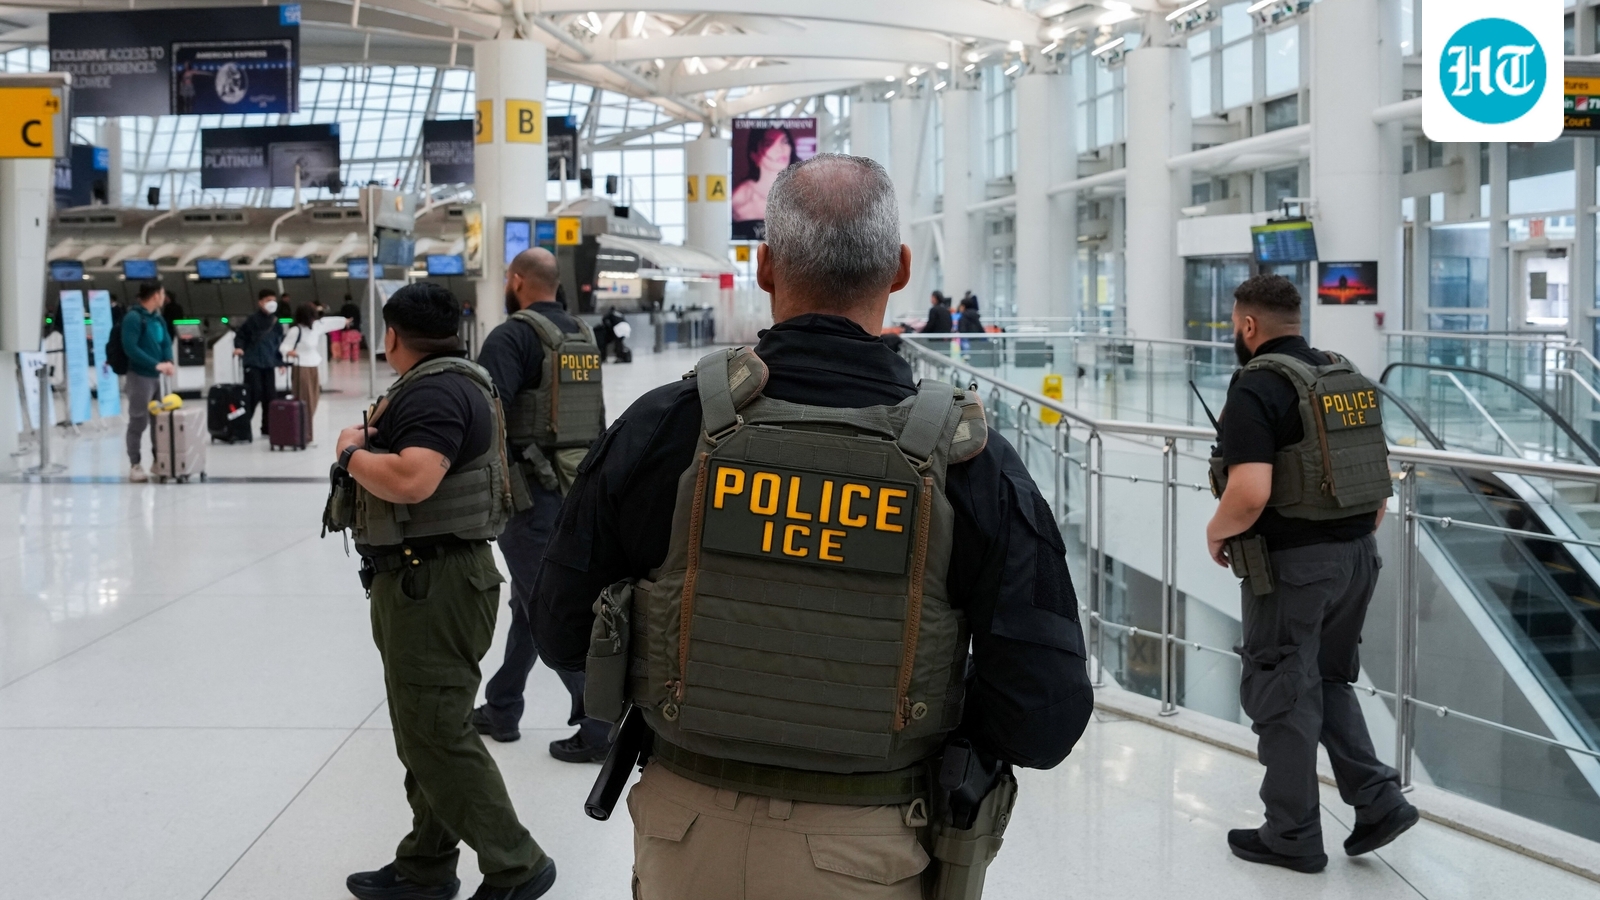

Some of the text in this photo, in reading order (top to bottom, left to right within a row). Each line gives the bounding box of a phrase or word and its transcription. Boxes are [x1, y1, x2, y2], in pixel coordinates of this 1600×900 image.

[52, 46, 165, 62] EXCLUSIVE ACCESS TO
[89, 60, 157, 75] EXPERIENCES
[1564, 81, 1589, 91] tures
[519, 109, 534, 135] B
[21, 119, 43, 148] C
[204, 154, 264, 168] PLATINUM
[712, 181, 725, 196] A
[566, 230, 574, 241] B
[561, 355, 599, 369] POLICE
[572, 370, 589, 381] ICE
[1323, 391, 1376, 413] POLICE
[1343, 411, 1365, 426] ICE
[712, 465, 908, 534] POLICE
[760, 520, 848, 563] ICE
